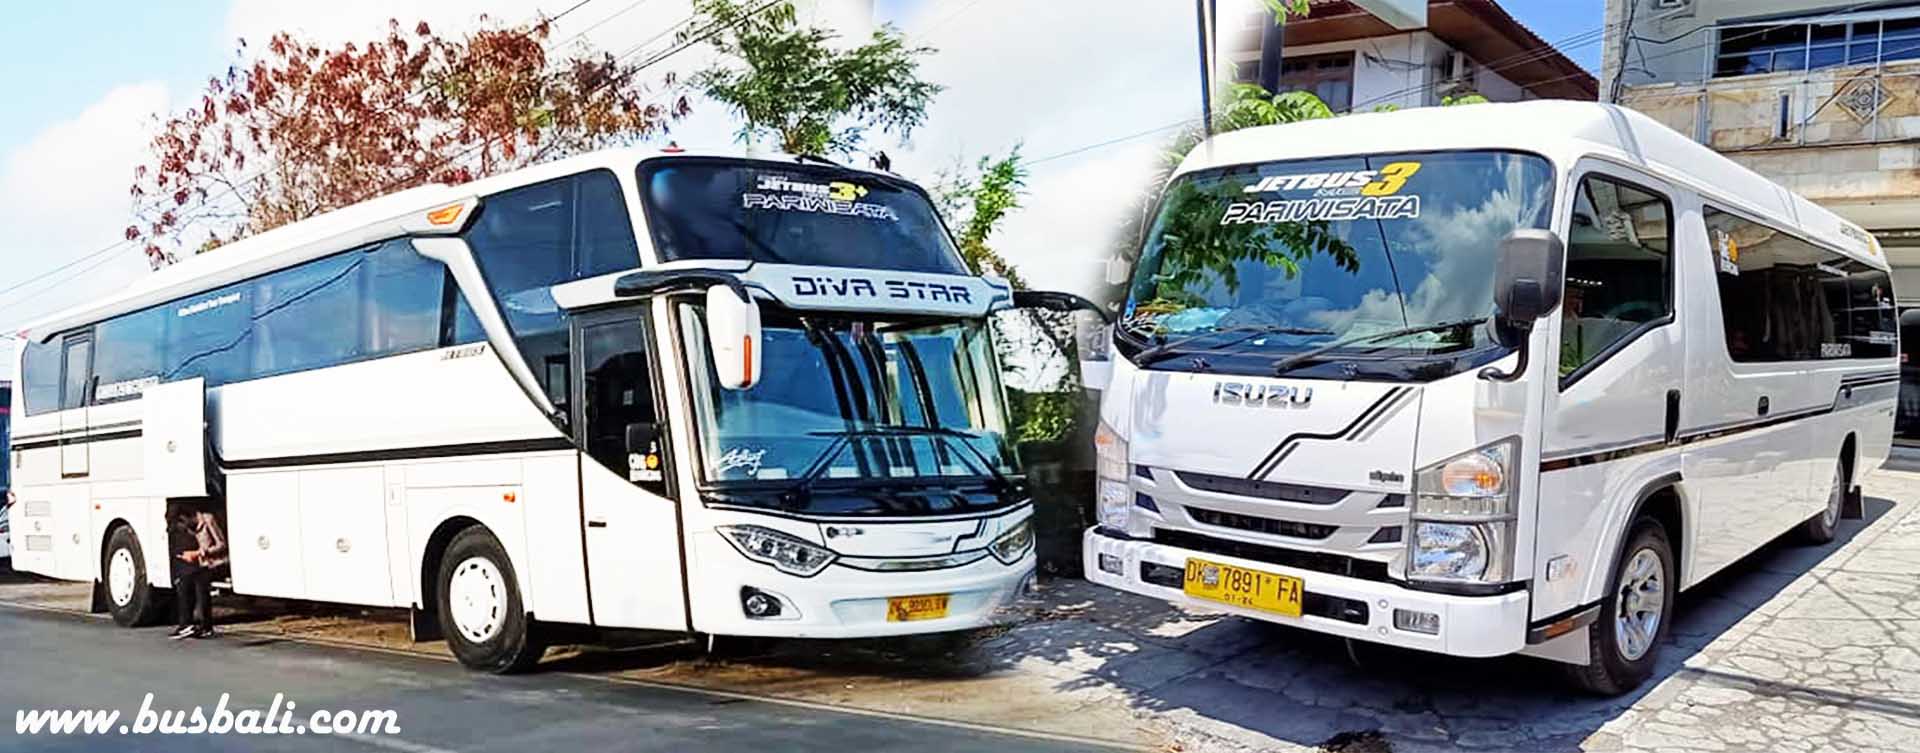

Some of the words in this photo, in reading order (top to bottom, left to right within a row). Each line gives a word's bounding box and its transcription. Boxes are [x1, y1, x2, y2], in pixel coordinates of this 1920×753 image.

[1243, 170, 1378, 193] JETBUS
[1360, 161, 1422, 197] 3
[743, 193, 899, 221] PARIWISATA
[1220, 196, 1420, 225] PARIWISATA
[884, 280, 972, 304] STAR
[1213, 381, 1313, 409] ISUZU
[1222, 567, 1262, 596] 7891
[1277, 577, 1299, 603] FA
